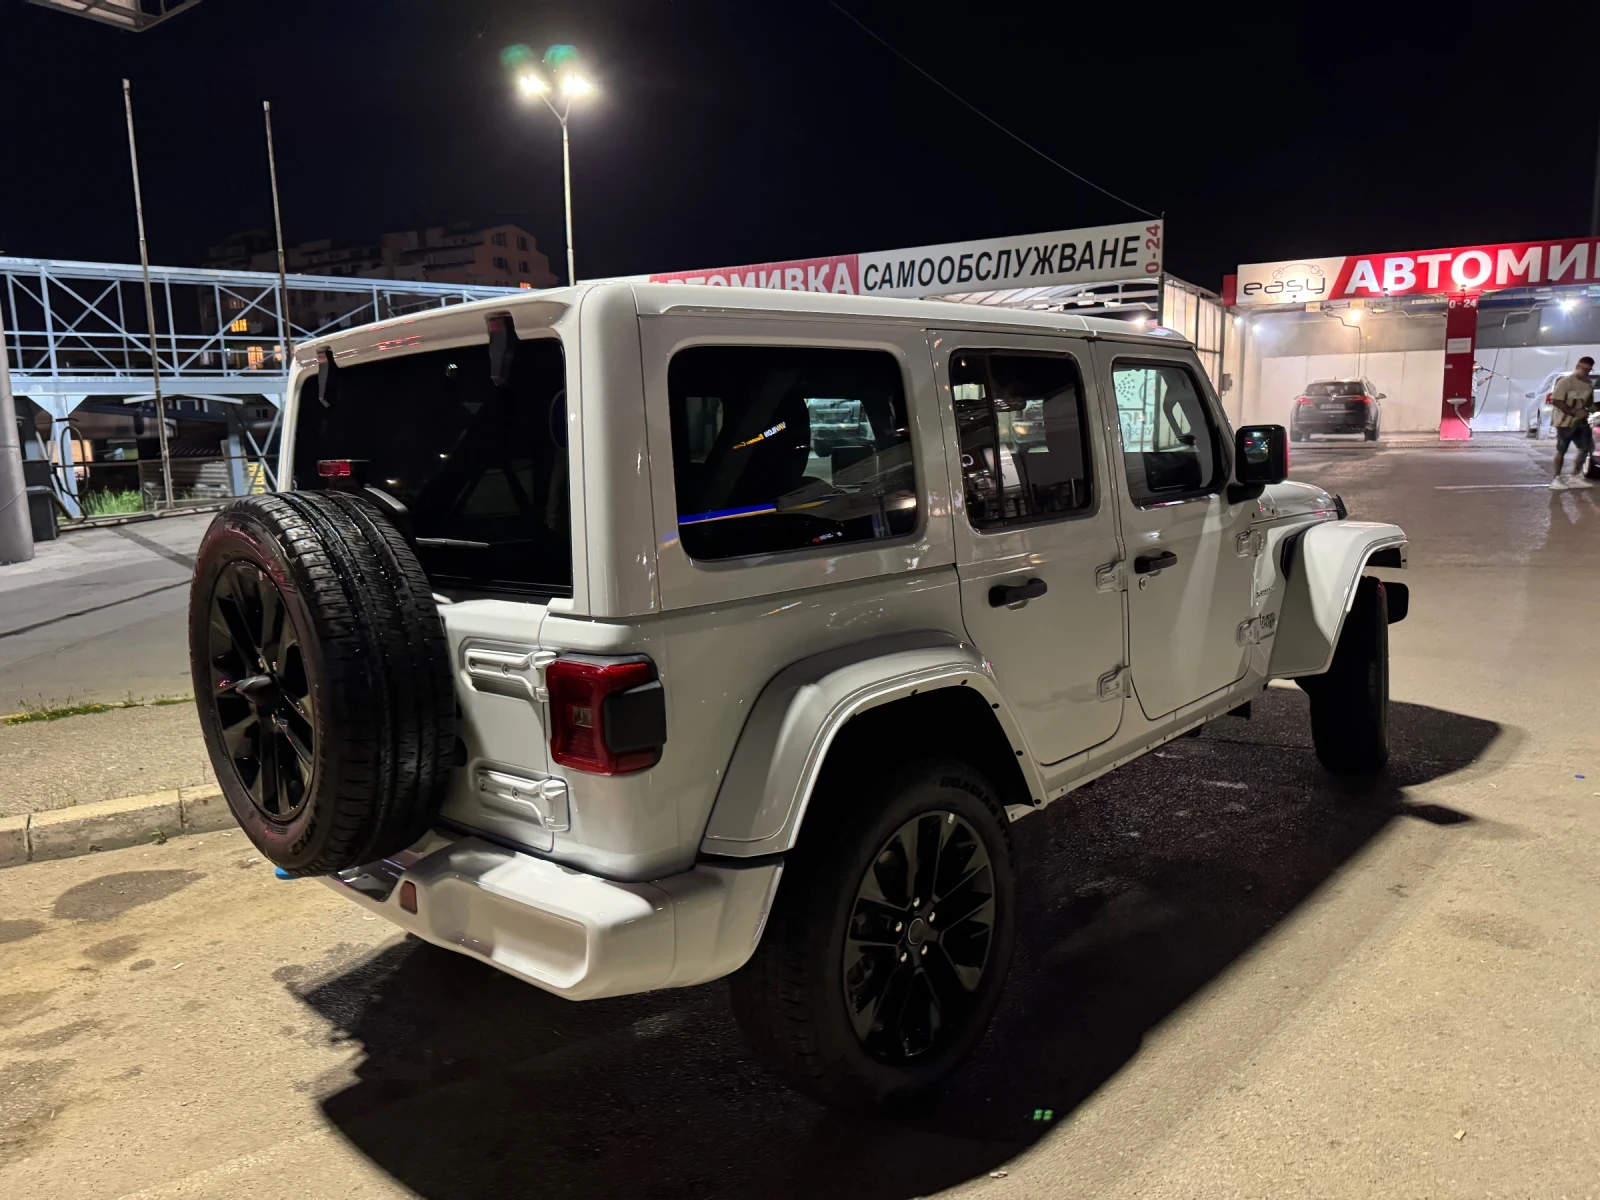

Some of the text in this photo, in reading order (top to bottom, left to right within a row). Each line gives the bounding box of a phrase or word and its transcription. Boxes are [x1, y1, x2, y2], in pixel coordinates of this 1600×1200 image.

[863, 235, 1140, 291] САМООБСЛУЖВАНЕ
[1243, 277, 1326, 296] easy
[1344, 242, 1600, 295] АВТОМИ
